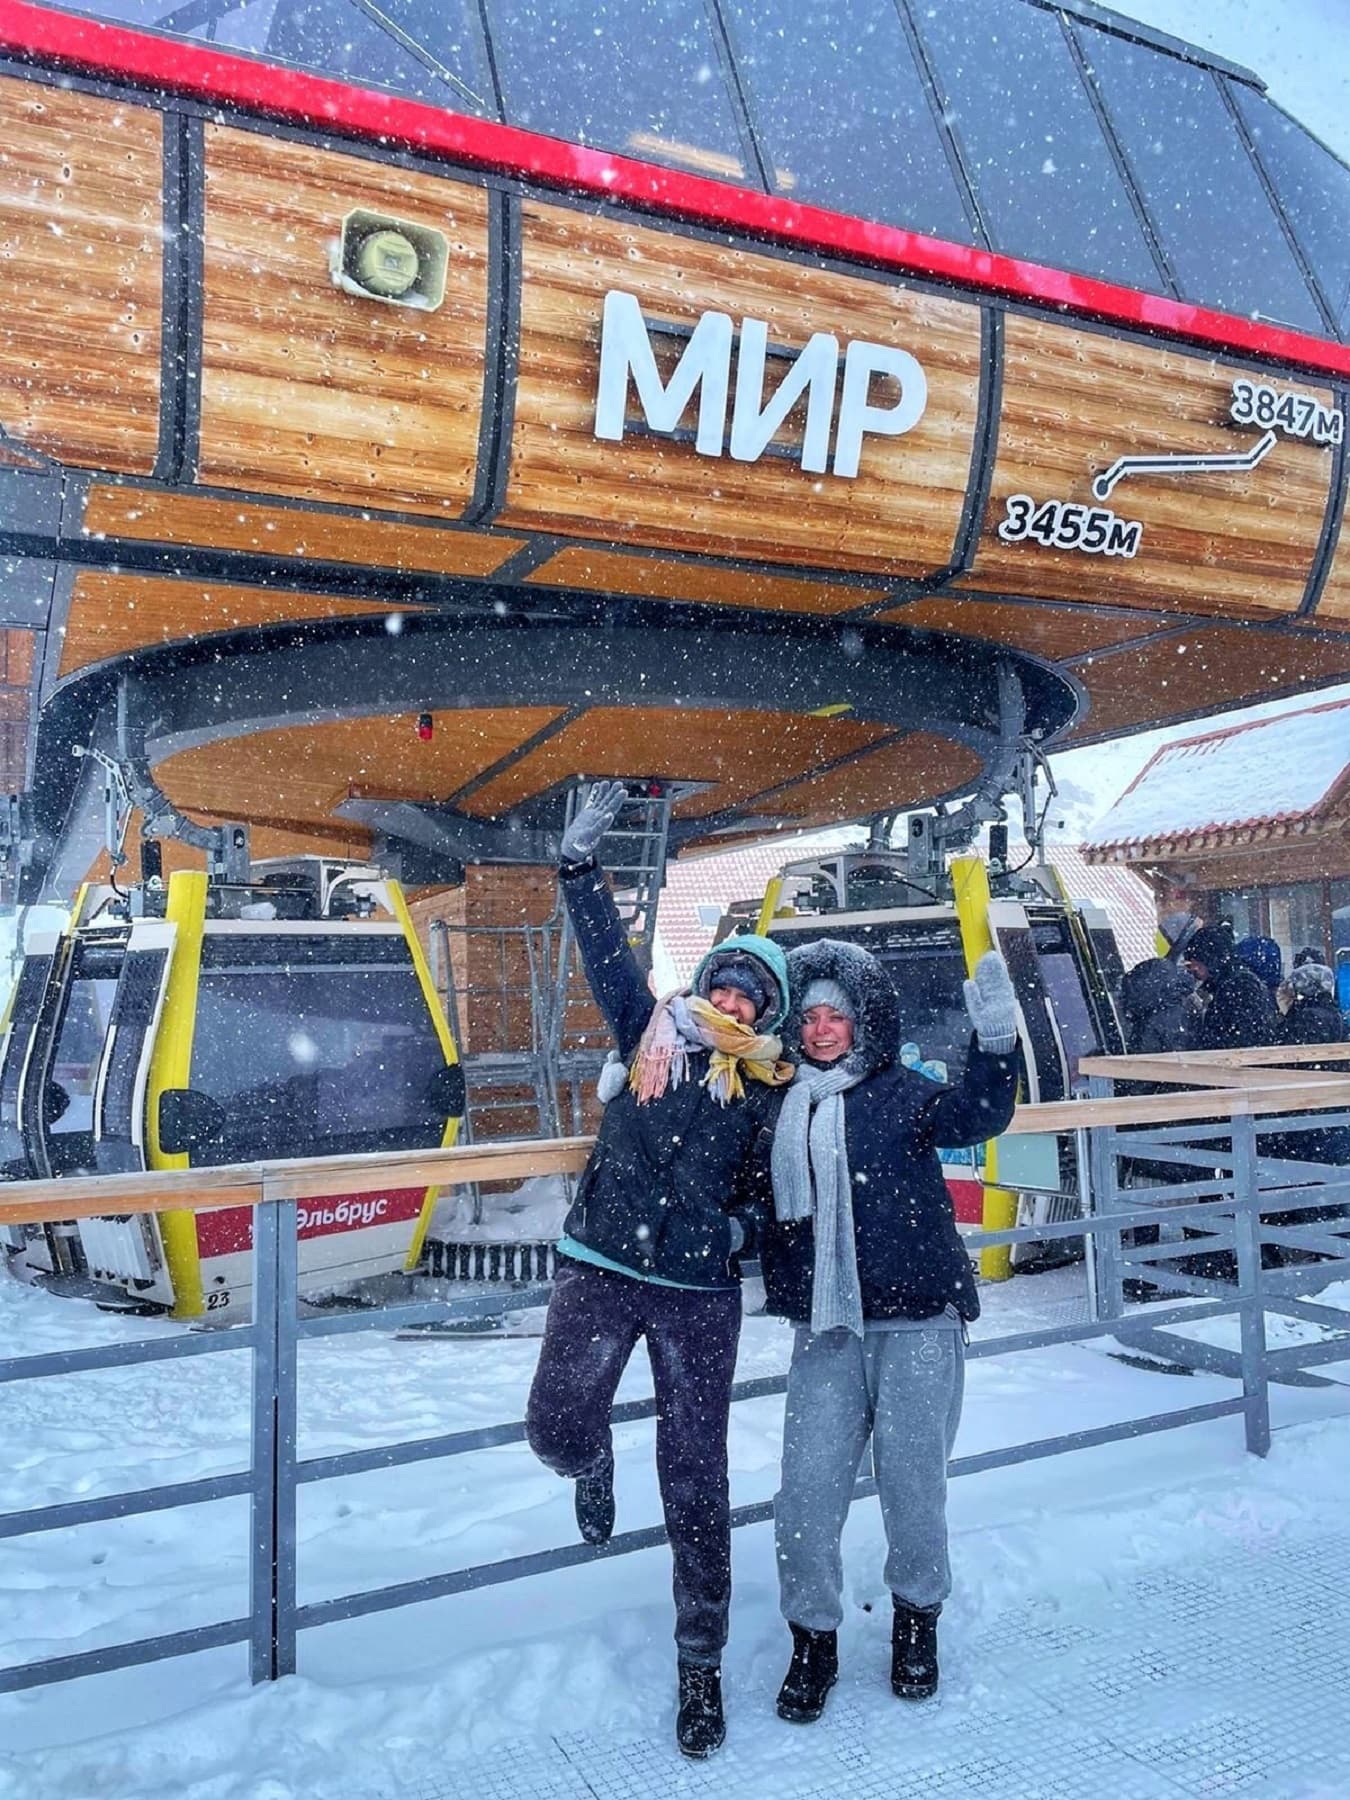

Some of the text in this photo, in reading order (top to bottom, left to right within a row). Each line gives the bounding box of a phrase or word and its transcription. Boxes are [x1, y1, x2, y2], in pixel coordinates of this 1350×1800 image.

[594, 290, 928, 478] МИР
[297, 1199, 388, 1230] Эльбрус
[207, 1291, 230, 1310] 23
